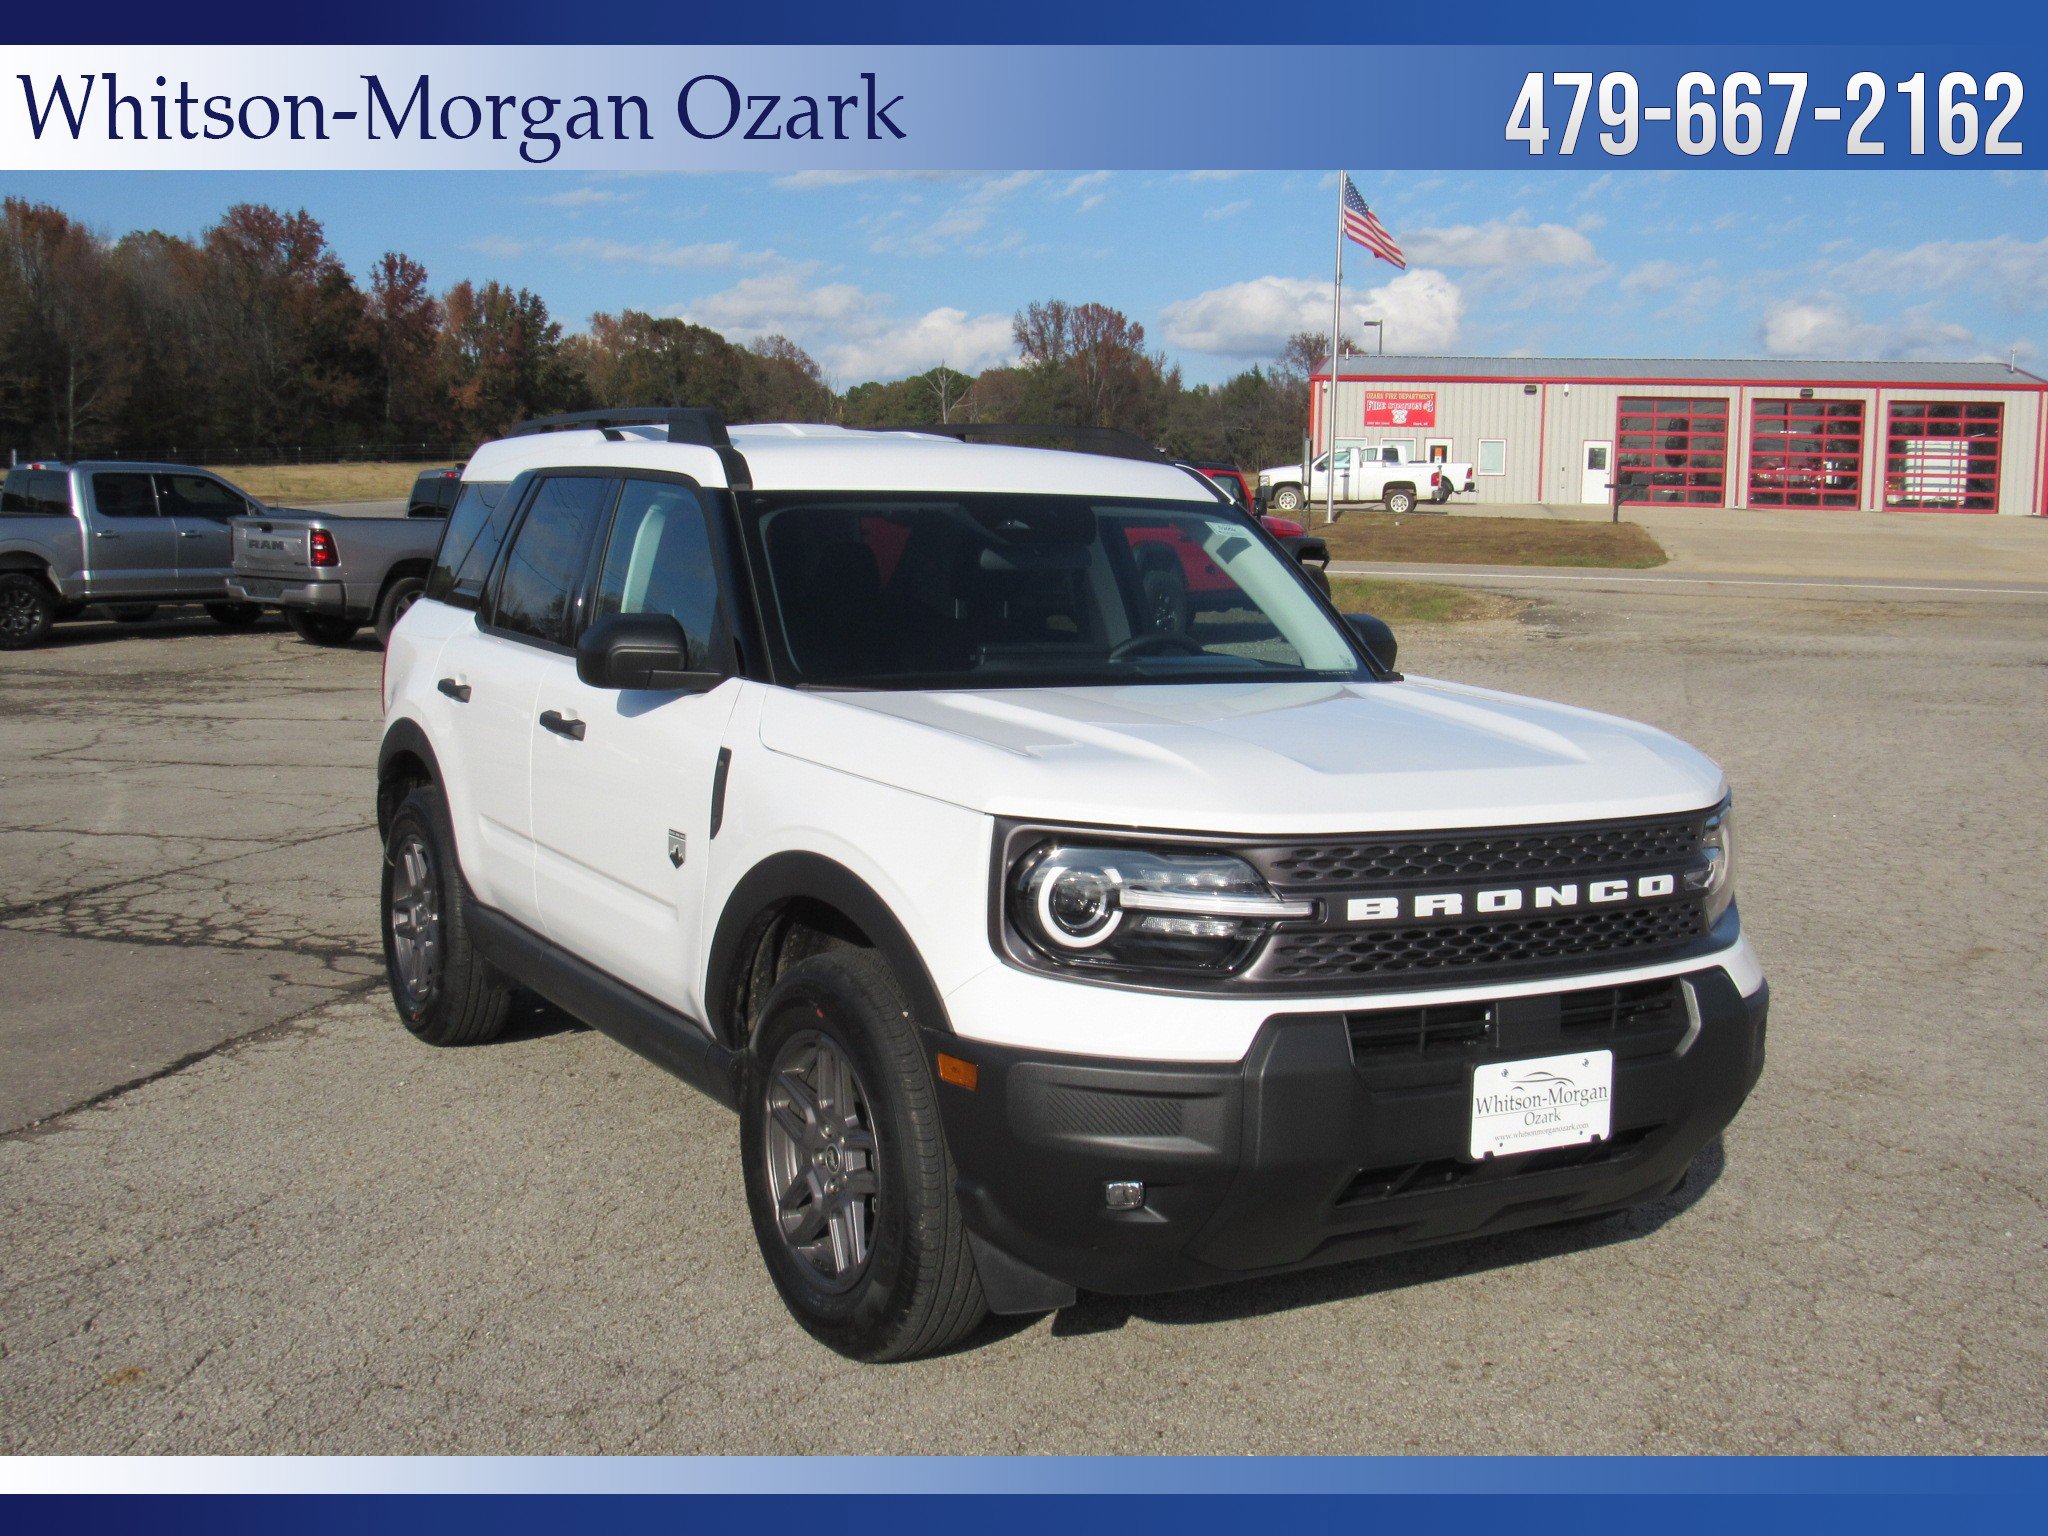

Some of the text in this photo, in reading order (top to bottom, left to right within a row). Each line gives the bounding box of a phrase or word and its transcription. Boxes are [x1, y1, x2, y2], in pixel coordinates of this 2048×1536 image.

[1366, 400, 1387, 412] FIRE
[249, 540, 285, 551] RAM
[1347, 874, 1674, 922] BRONCO
[1475, 1085, 1608, 1116] Whitson-Morgan
[1524, 1108, 1562, 1126] Ozark
[1494, 1121, 1589, 1142] www.whitsonmorganozark.com
